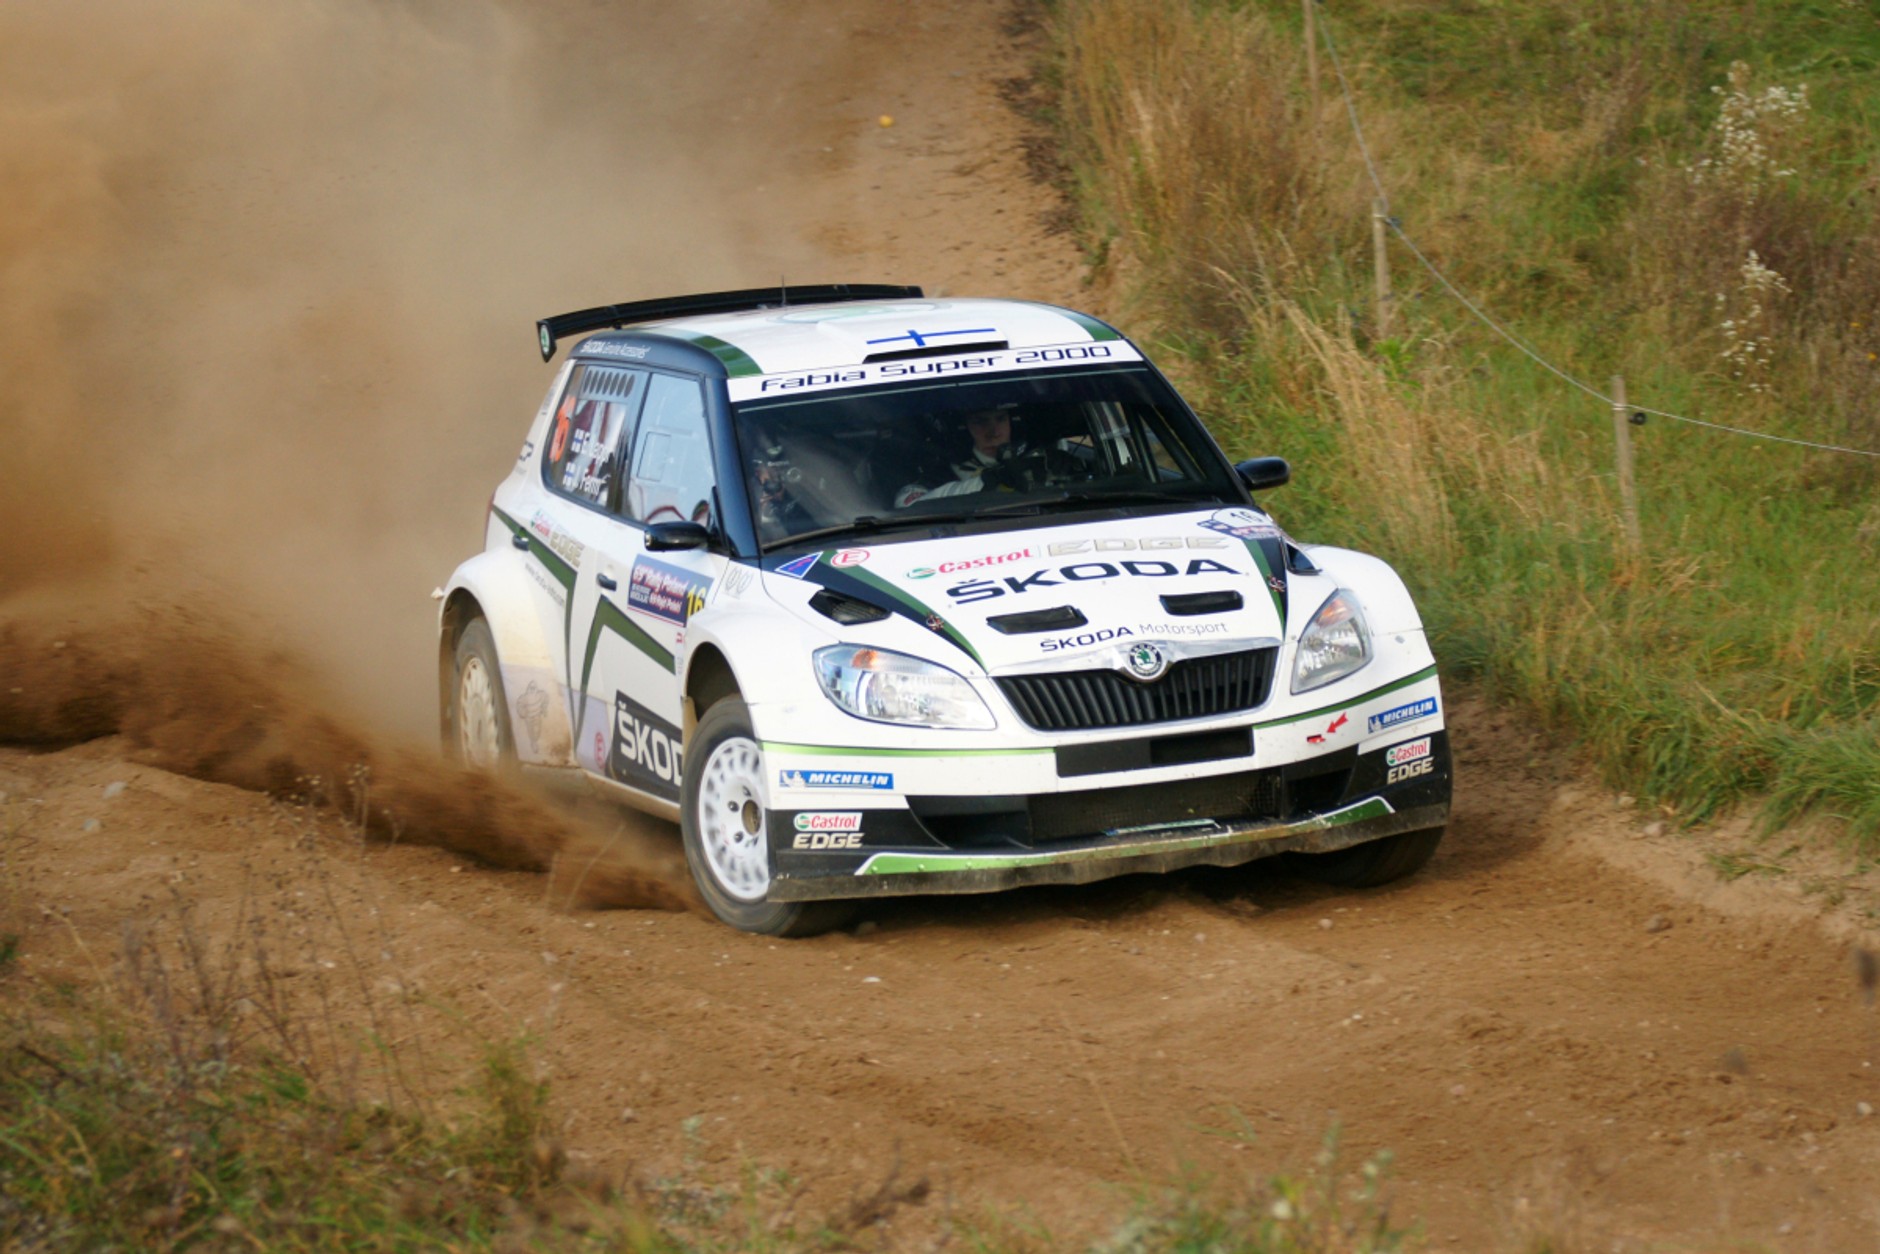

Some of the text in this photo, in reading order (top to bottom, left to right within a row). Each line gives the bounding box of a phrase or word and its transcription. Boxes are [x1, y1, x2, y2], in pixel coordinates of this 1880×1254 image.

[761, 346, 1112, 392] Fabia Super 2000
[939, 536, 1230, 574] Castrol EDGE
[946, 559, 1242, 605] ŠKODA
[686, 584, 708, 618] 16
[1039, 627, 1134, 653] ŠKODA
[1139, 622, 1230, 637] Motorsport
[1383, 700, 1434, 724] MICHELIN
[617, 700, 683, 787] ŠKOD
[1395, 740, 1428, 762] Castrol
[808, 773, 889, 786] MICHELIN
[1387, 756, 1435, 785] EDGE
[811, 815, 857, 829] Castrol
[792, 832, 865, 849] EDGE
